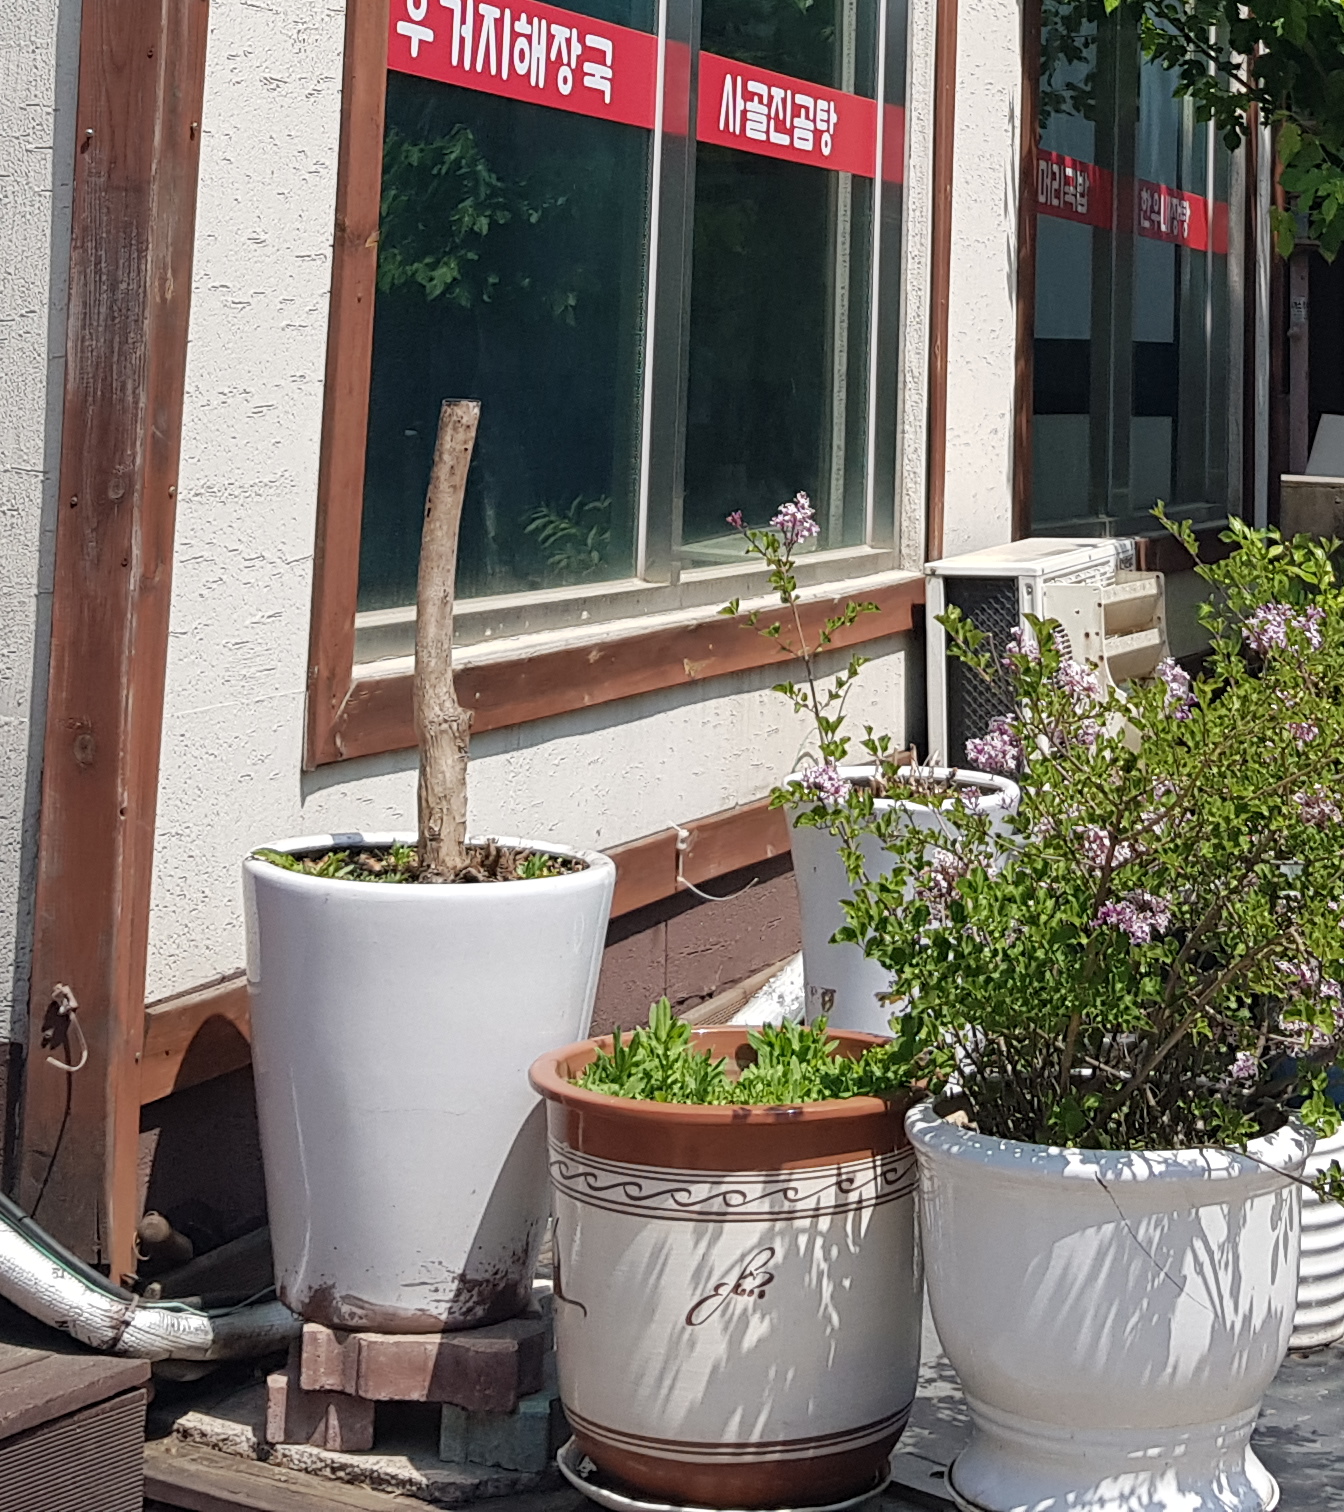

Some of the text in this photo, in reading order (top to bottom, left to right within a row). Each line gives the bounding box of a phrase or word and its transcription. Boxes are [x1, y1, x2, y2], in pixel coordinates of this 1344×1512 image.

[718, 72, 838, 158] 사골진곰탕
[1038, 159, 1090, 214] 머리국밥
[1140, 186, 1191, 239] 한우내장탕
